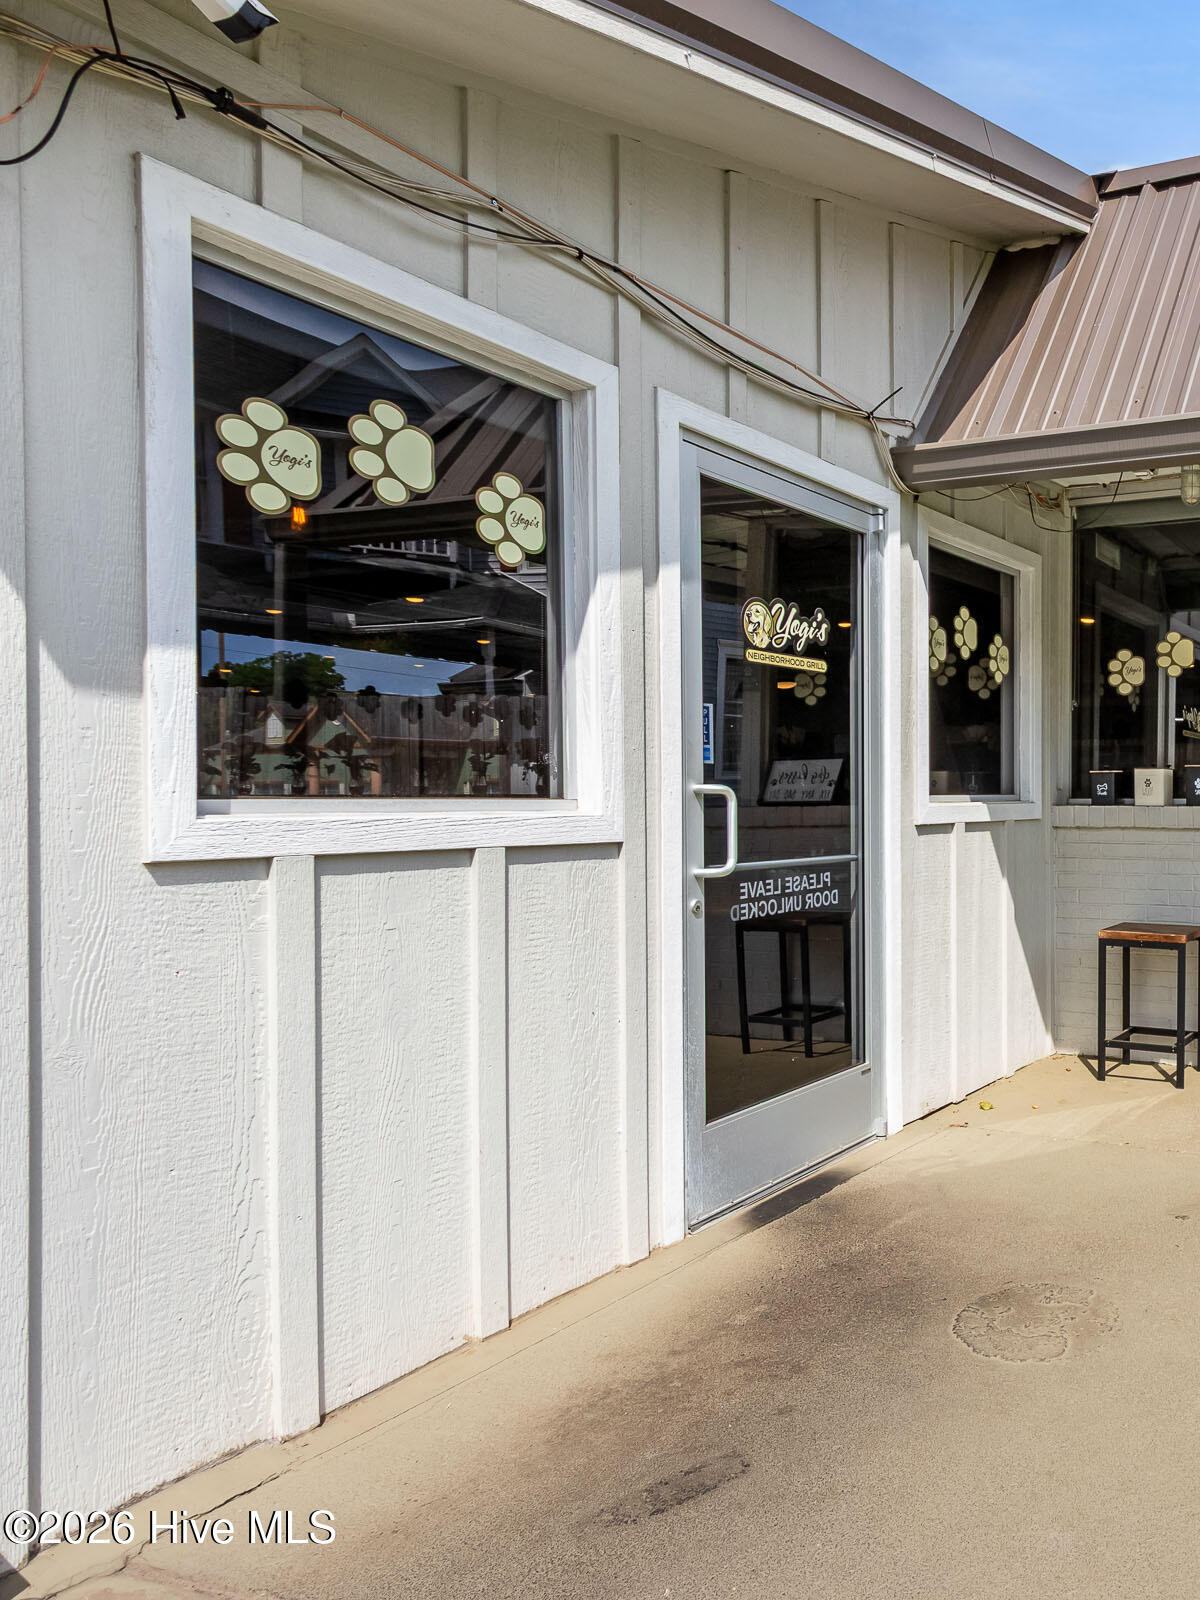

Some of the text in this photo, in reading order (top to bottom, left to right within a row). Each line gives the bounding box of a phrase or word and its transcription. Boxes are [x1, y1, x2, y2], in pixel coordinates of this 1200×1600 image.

[268, 445, 313, 470] Yogi's
[510, 510, 540, 531] Yogi's
[770, 603, 828, 652] Yogi's
[747, 651, 825, 670] NEIGHBORHOOD GRILL
